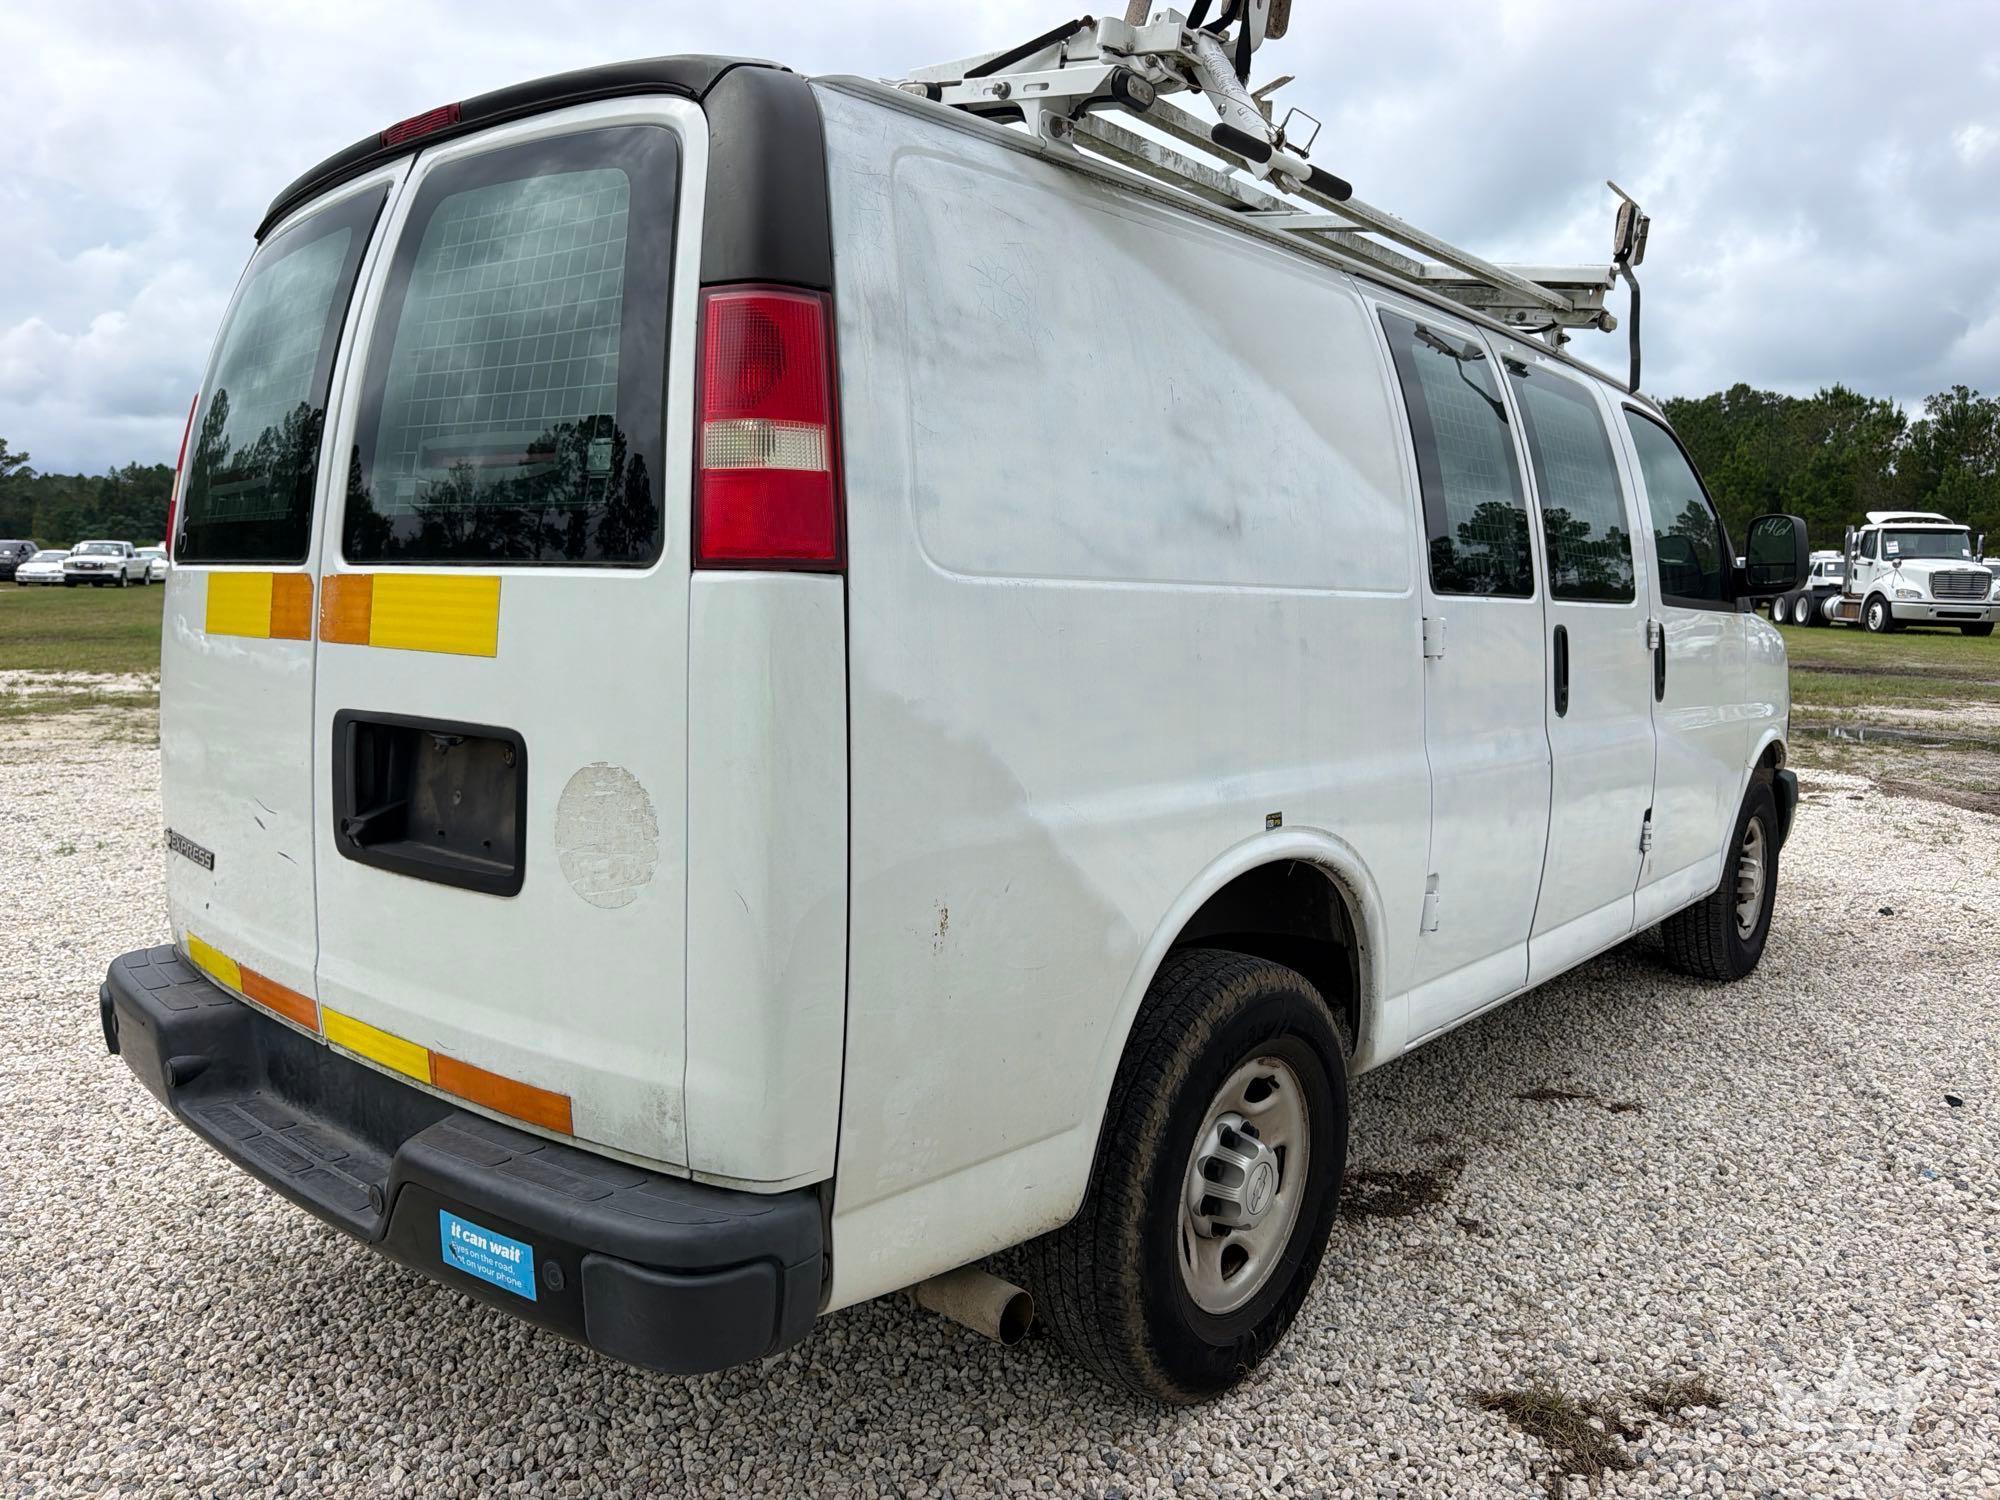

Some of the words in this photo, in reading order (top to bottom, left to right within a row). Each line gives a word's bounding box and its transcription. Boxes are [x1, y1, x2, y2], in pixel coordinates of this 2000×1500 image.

[172, 835, 211, 868] EXPRESS
[452, 1222, 461, 1238] it
[463, 1231, 487, 1249] can
[490, 1241, 520, 1263] wait
[452, 1241, 469, 1255] Eyes
[469, 1250, 480, 1260] on
[480, 1253, 494, 1266] the
[495, 1261, 515, 1275] road,
[466, 1259, 477, 1269] on
[477, 1264, 494, 1276] your
